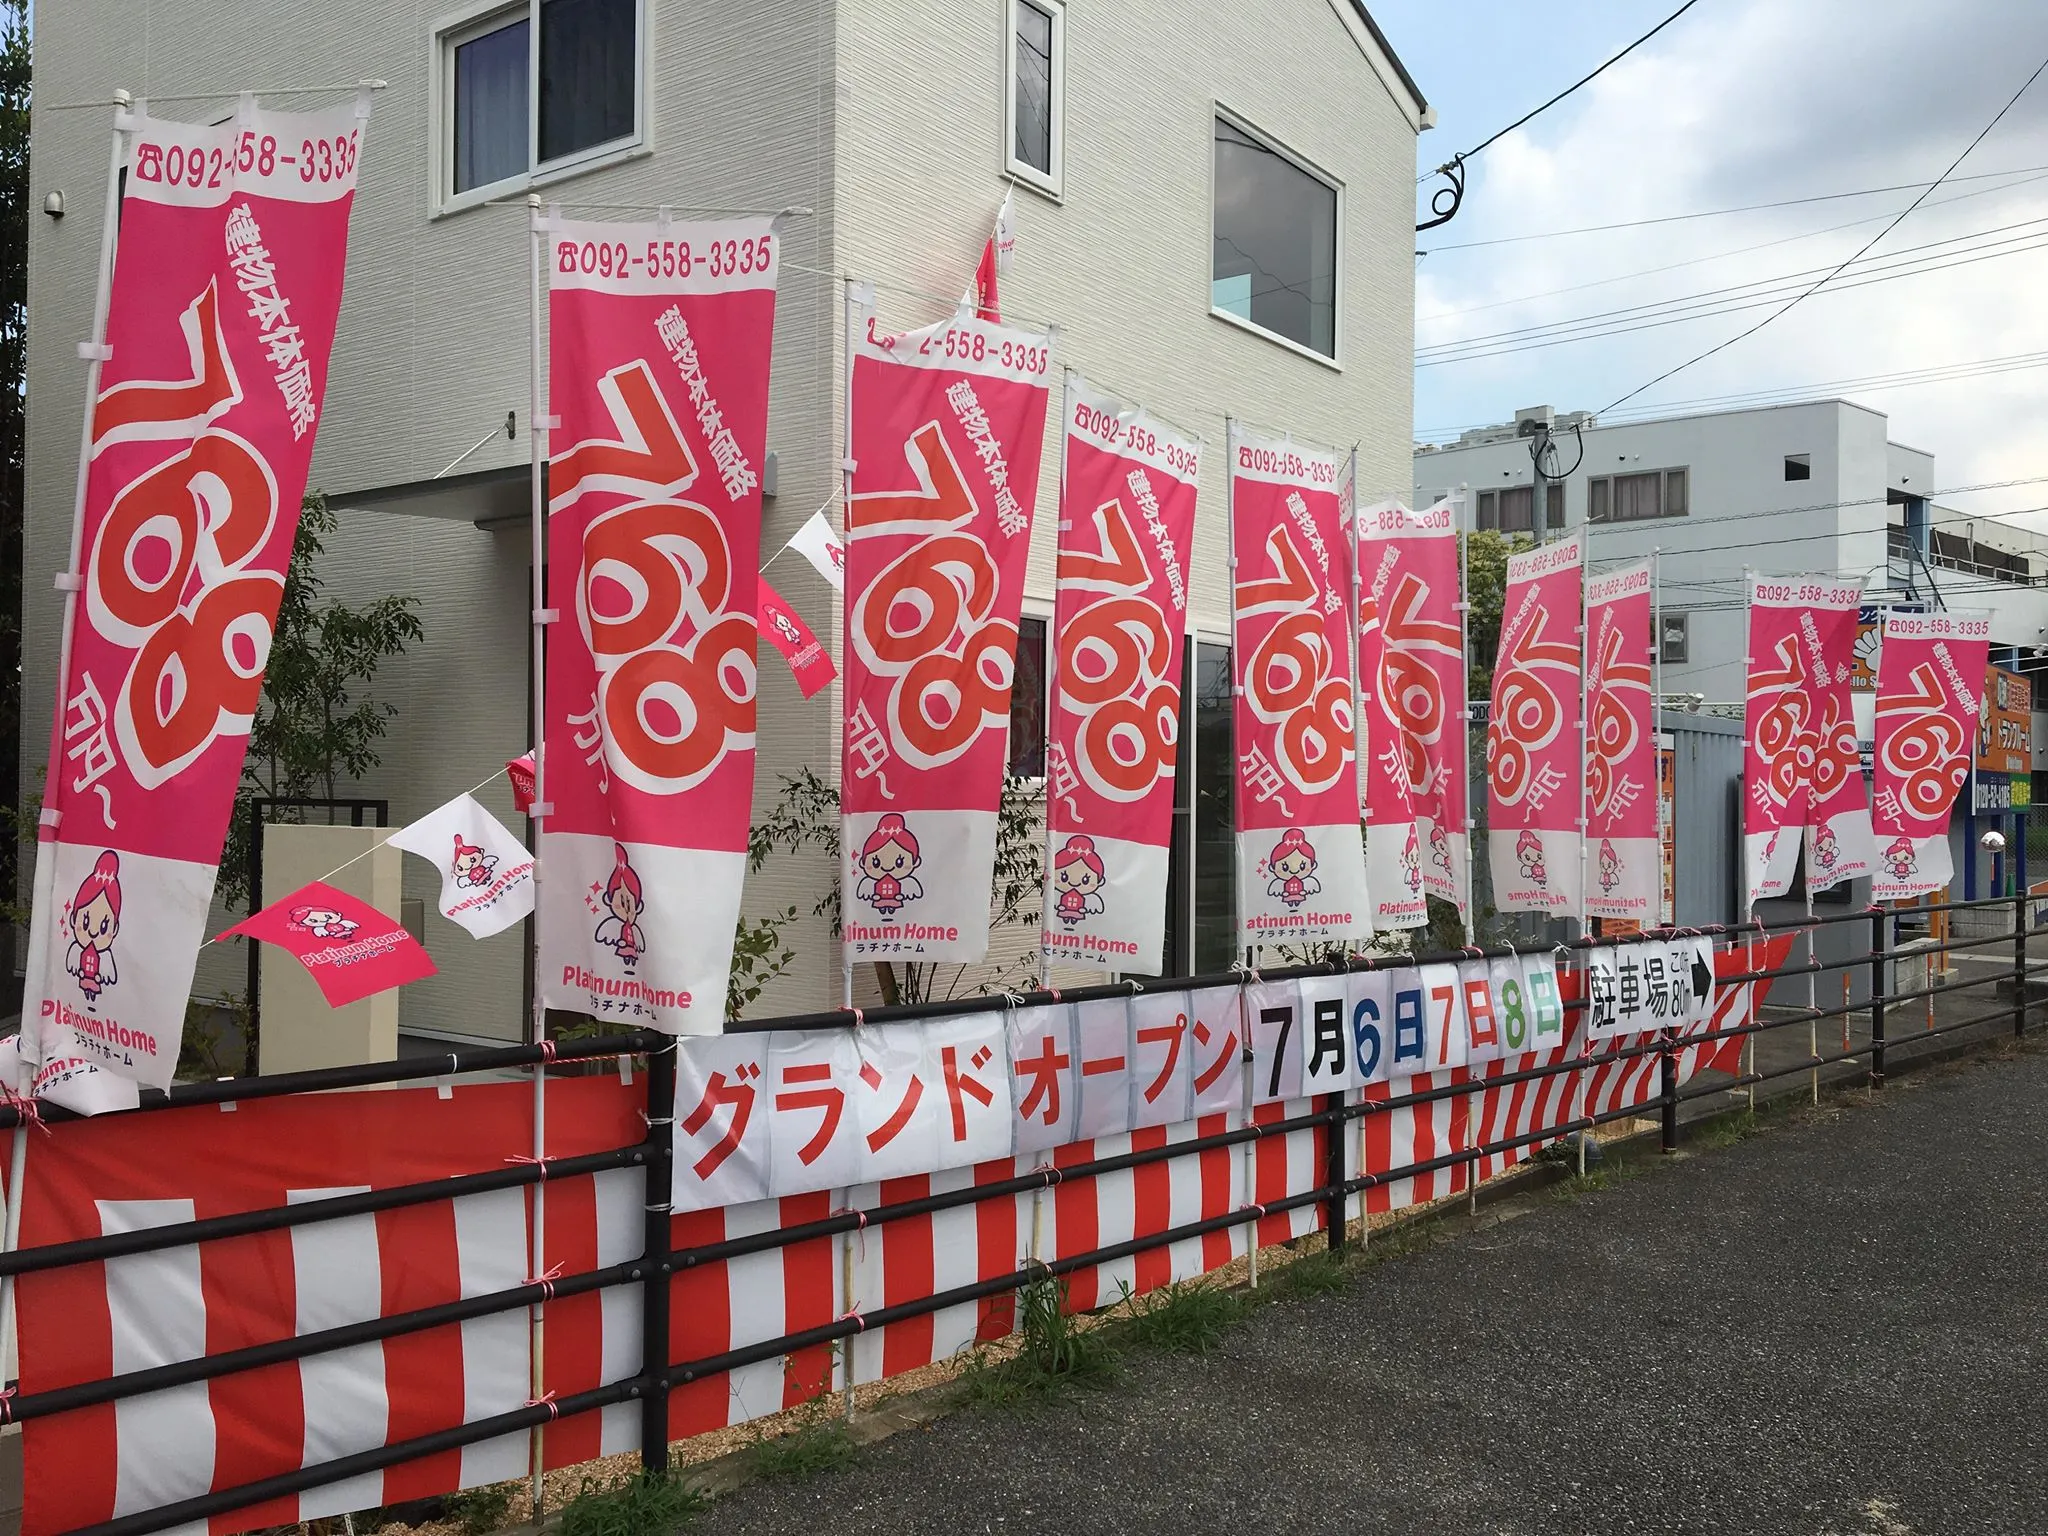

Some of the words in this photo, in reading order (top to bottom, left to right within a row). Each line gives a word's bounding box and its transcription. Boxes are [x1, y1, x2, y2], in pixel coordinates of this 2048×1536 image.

[580, 235, 772, 279] 092-558-3335
[225, 202, 316, 442] 建物本体価格
[653, 303, 758, 502] 建物本体価格
[944, 378, 1029, 540] 建物本体価格
[1090, 405, 1198, 476] 092-558-3335
[1126, 468, 1186, 612] 建物本体価格
[1900, 619, 1989, 636] 092-558-3335
[1932, 641, 1980, 716] 建物本体価格
[446, 880, 505, 917] Platinum
[503, 862, 534, 882] Hom
[475, 874, 529, 911] プラチナホーム
[903, 923, 958, 941] Home
[1256, 928, 1329, 939] プラチナホーム
[1307, 911, 1353, 926] Home
[302, 942, 366, 966] Platinum
[365, 930, 409, 950] Home
[334, 944, 396, 967] プラチナホーム
[1083, 933, 1138, 955] Home
[562, 965, 641, 997] Platinum
[642, 987, 692, 1009] Home
[1590, 954, 1669, 1029] 駐車場
[106, 1018, 157, 1056] Home
[679, 1012, 1238, 1182] グランドオープン
